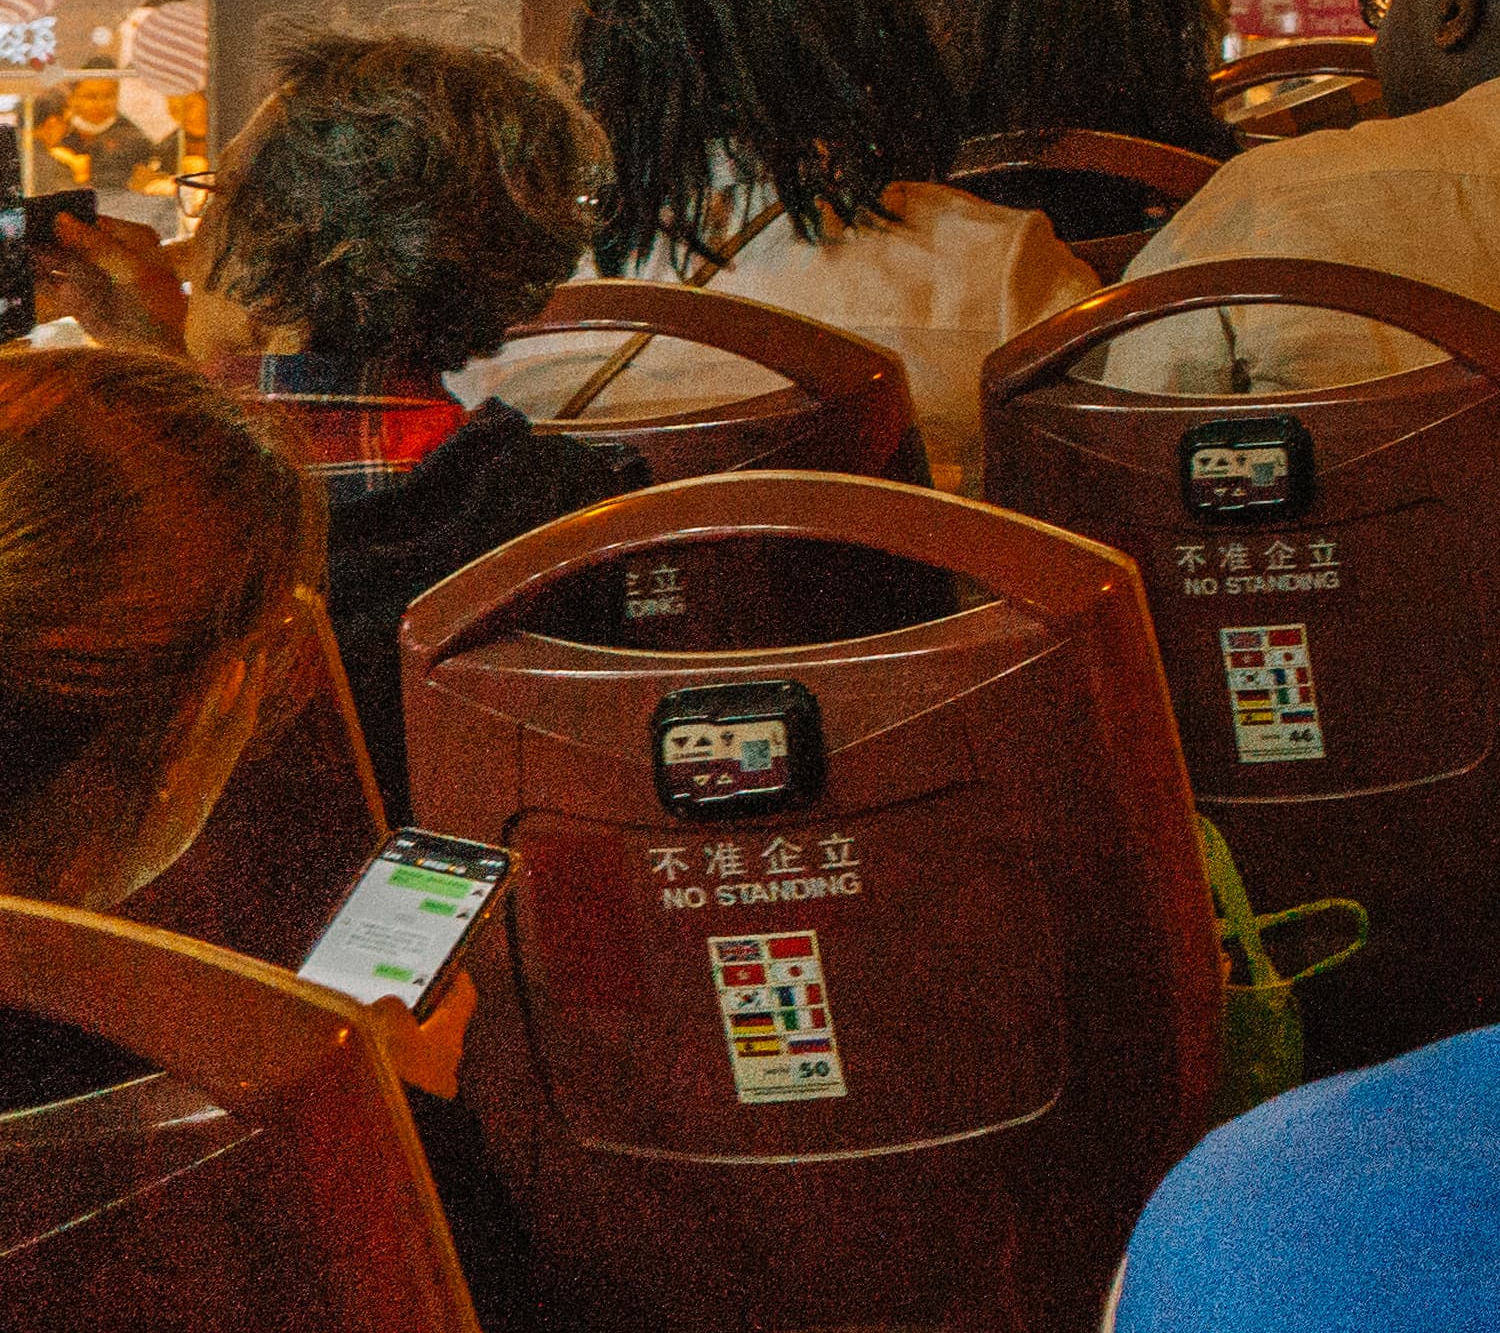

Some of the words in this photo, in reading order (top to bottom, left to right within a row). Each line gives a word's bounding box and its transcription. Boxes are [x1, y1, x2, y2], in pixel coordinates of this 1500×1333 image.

[1175, 537, 1341, 574] 不准企立
[1184, 576, 1219, 596] NO
[1226, 570, 1341, 594] STANDING
[648, 833, 860, 882] 不准企立
[663, 886, 705, 910] NO
[716, 872, 861, 908] STANDING
[799, 1060, 831, 1080] 50
